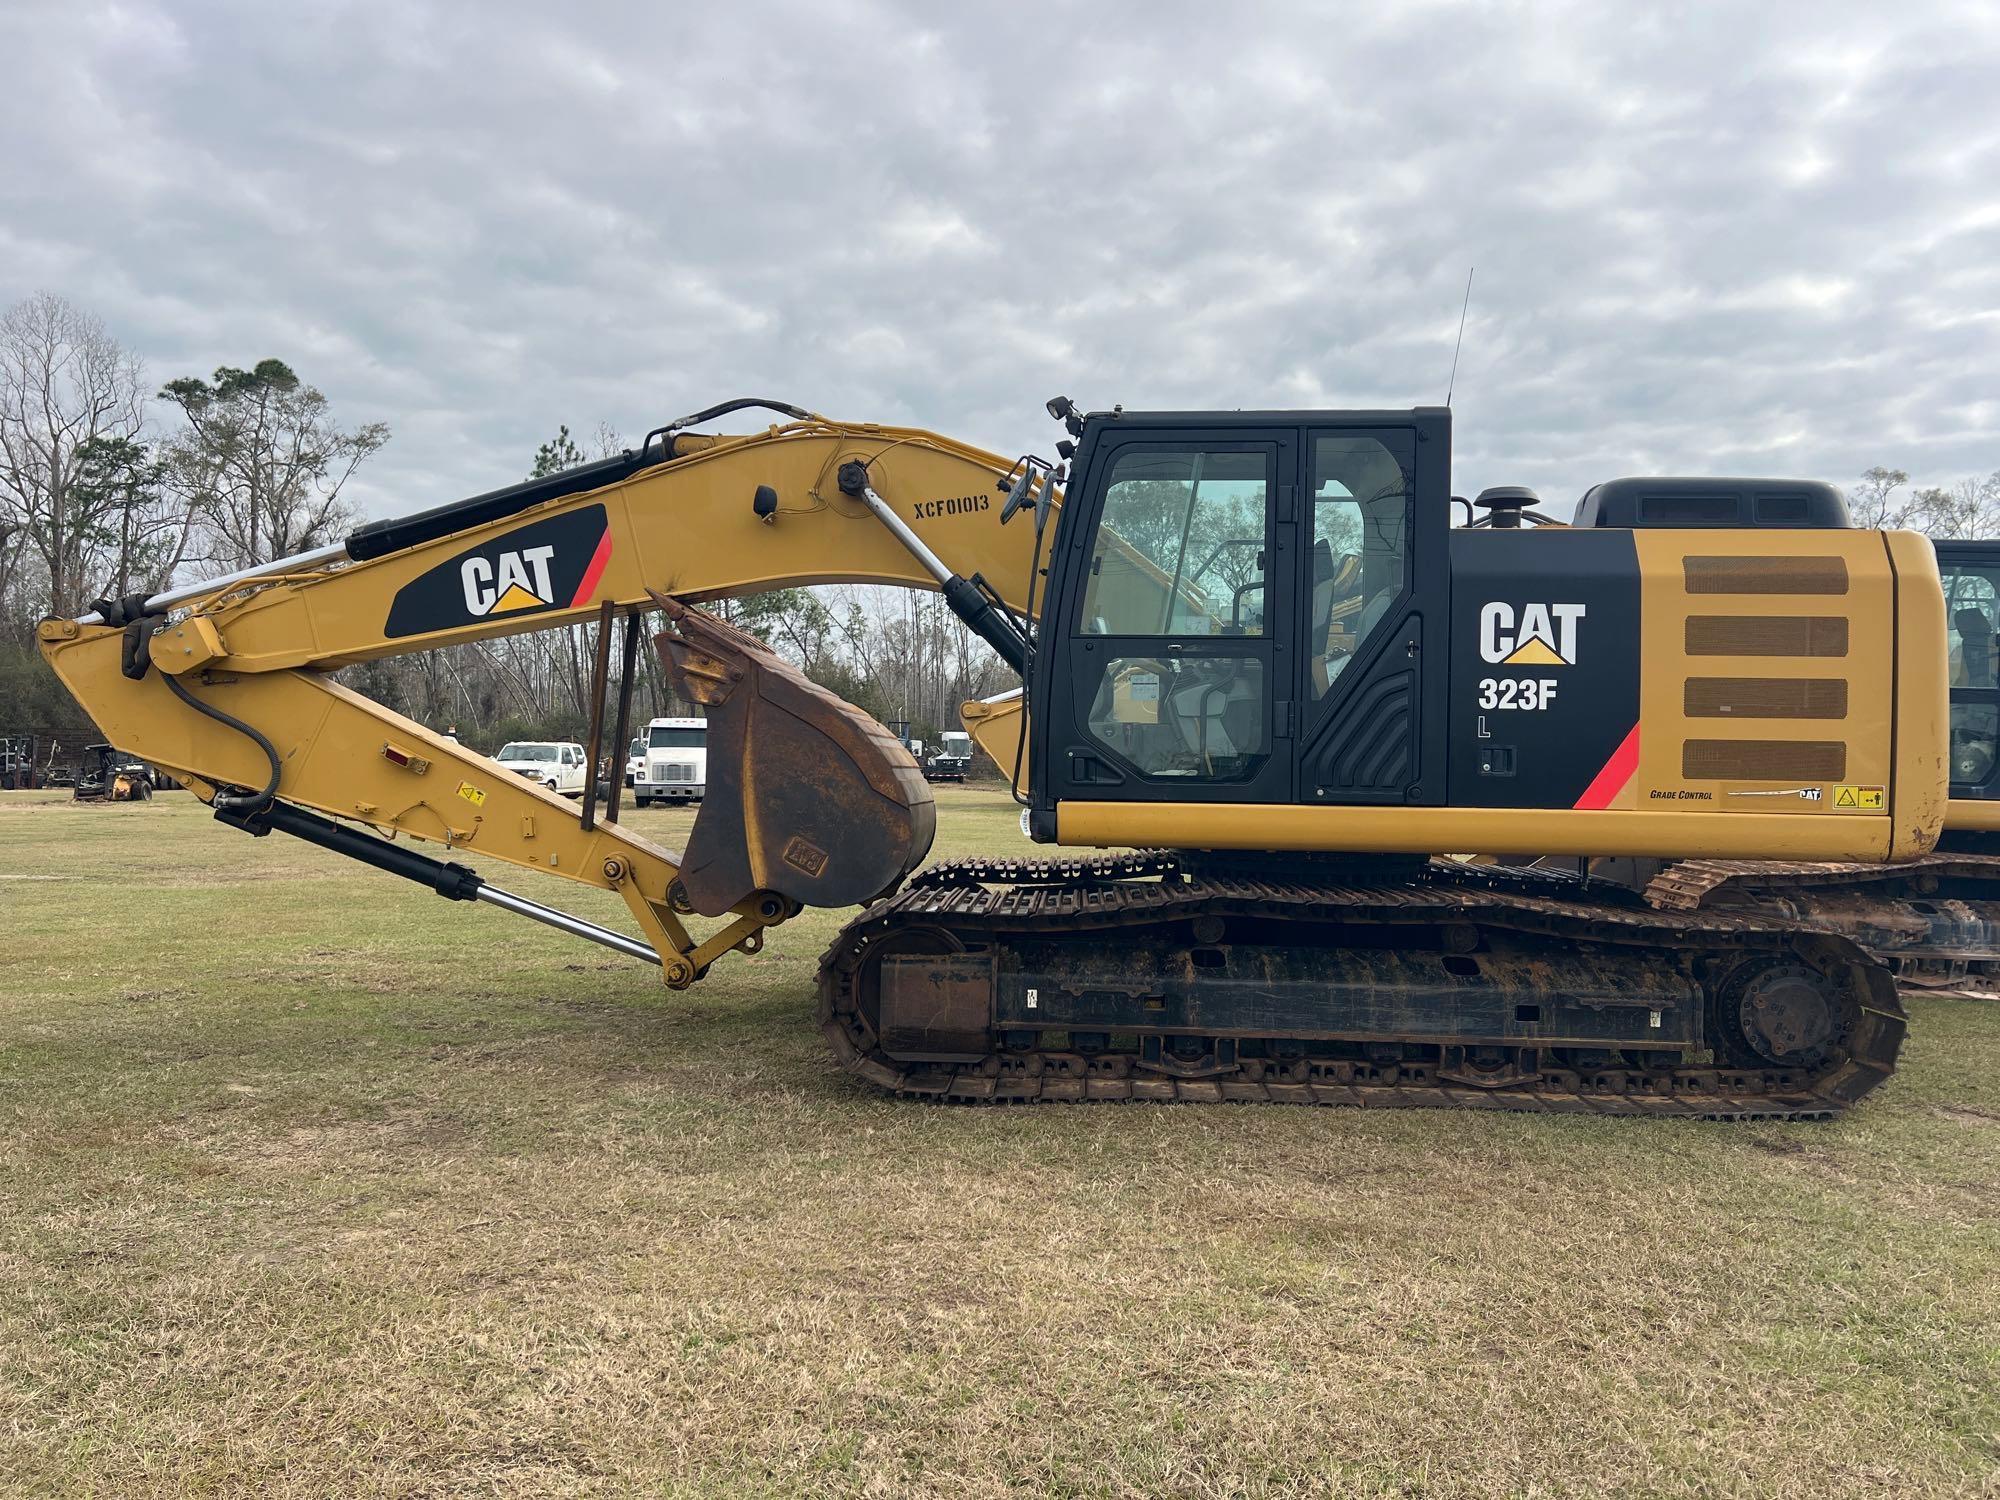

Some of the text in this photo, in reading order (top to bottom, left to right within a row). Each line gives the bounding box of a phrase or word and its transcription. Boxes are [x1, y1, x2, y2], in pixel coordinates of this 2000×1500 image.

[913, 494, 990, 520] XCF01013
[461, 545, 555, 616] CAT
[1480, 601, 1586, 665] CAT
[1478, 678, 1558, 711] 323F
[1477, 715, 1491, 738] L
[957, 759, 963, 767] 2
